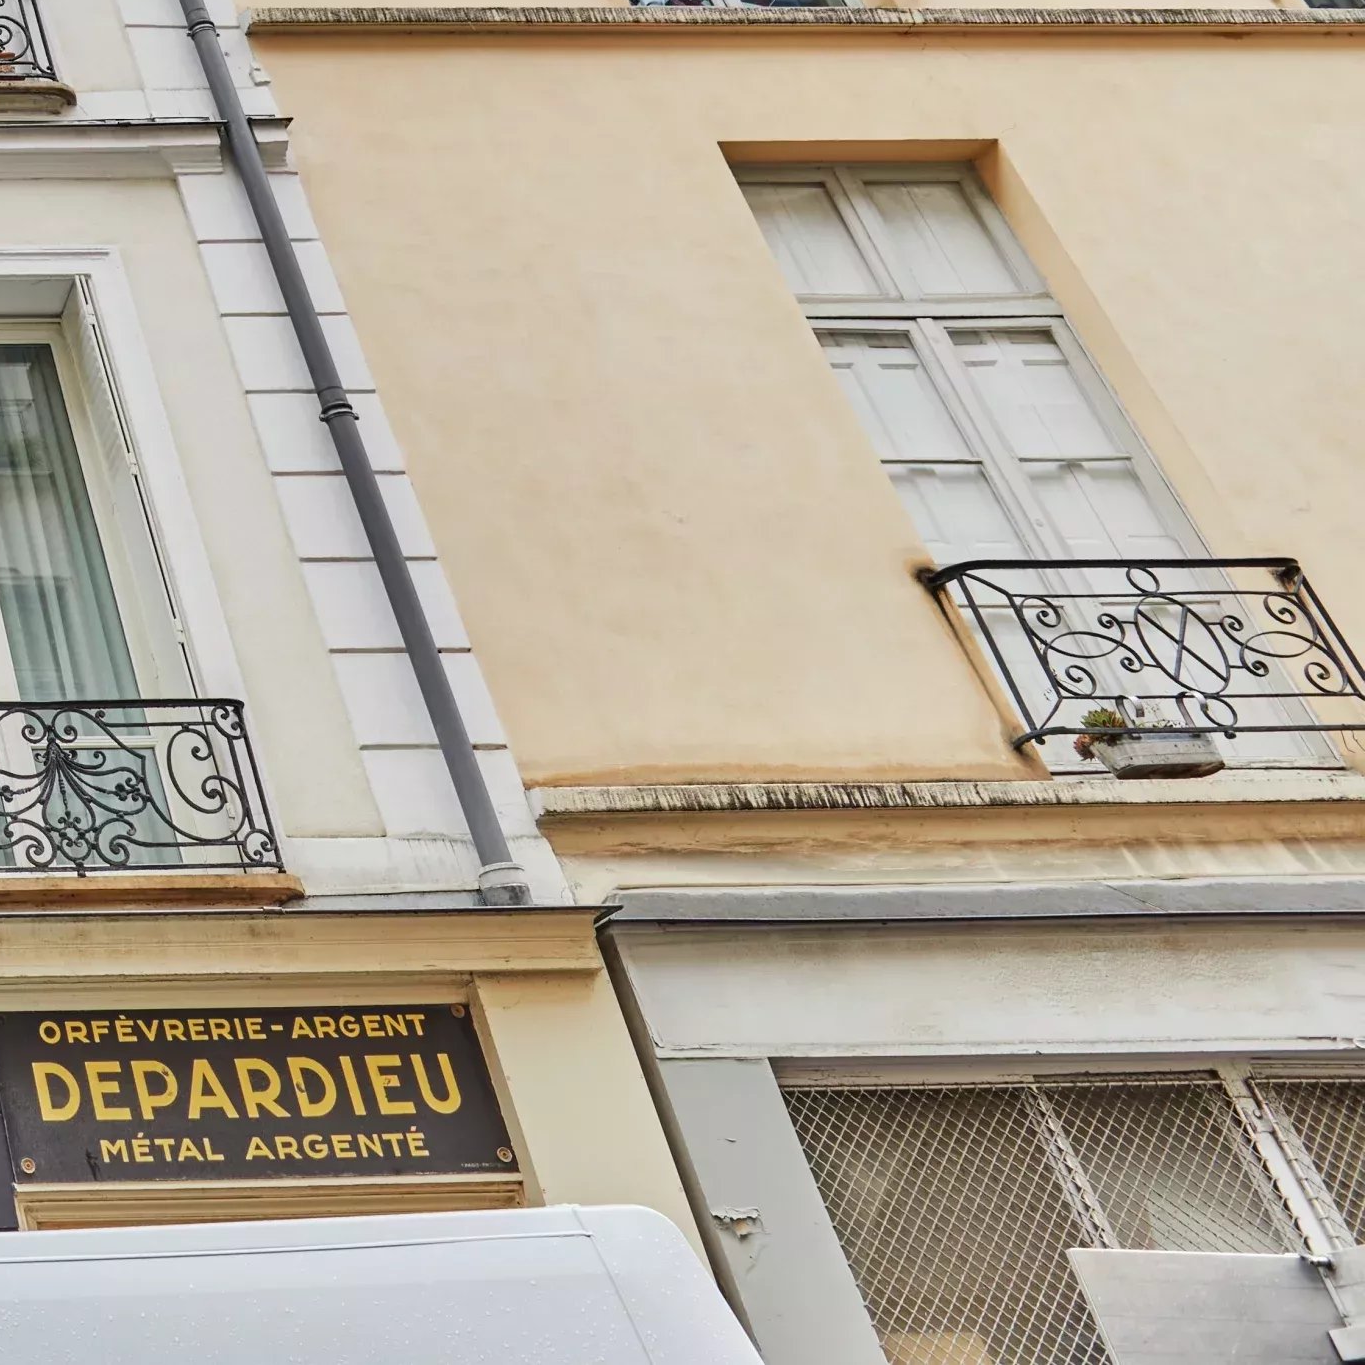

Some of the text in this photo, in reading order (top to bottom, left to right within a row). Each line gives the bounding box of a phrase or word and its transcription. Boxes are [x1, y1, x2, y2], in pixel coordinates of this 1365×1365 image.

[38, 1013, 427, 1045] ORFÈVRERIE-ARGENT
[31, 1052, 463, 1123] DEPARDIEU
[99, 1125, 431, 1164] MÉTAL ARGENTÉ
